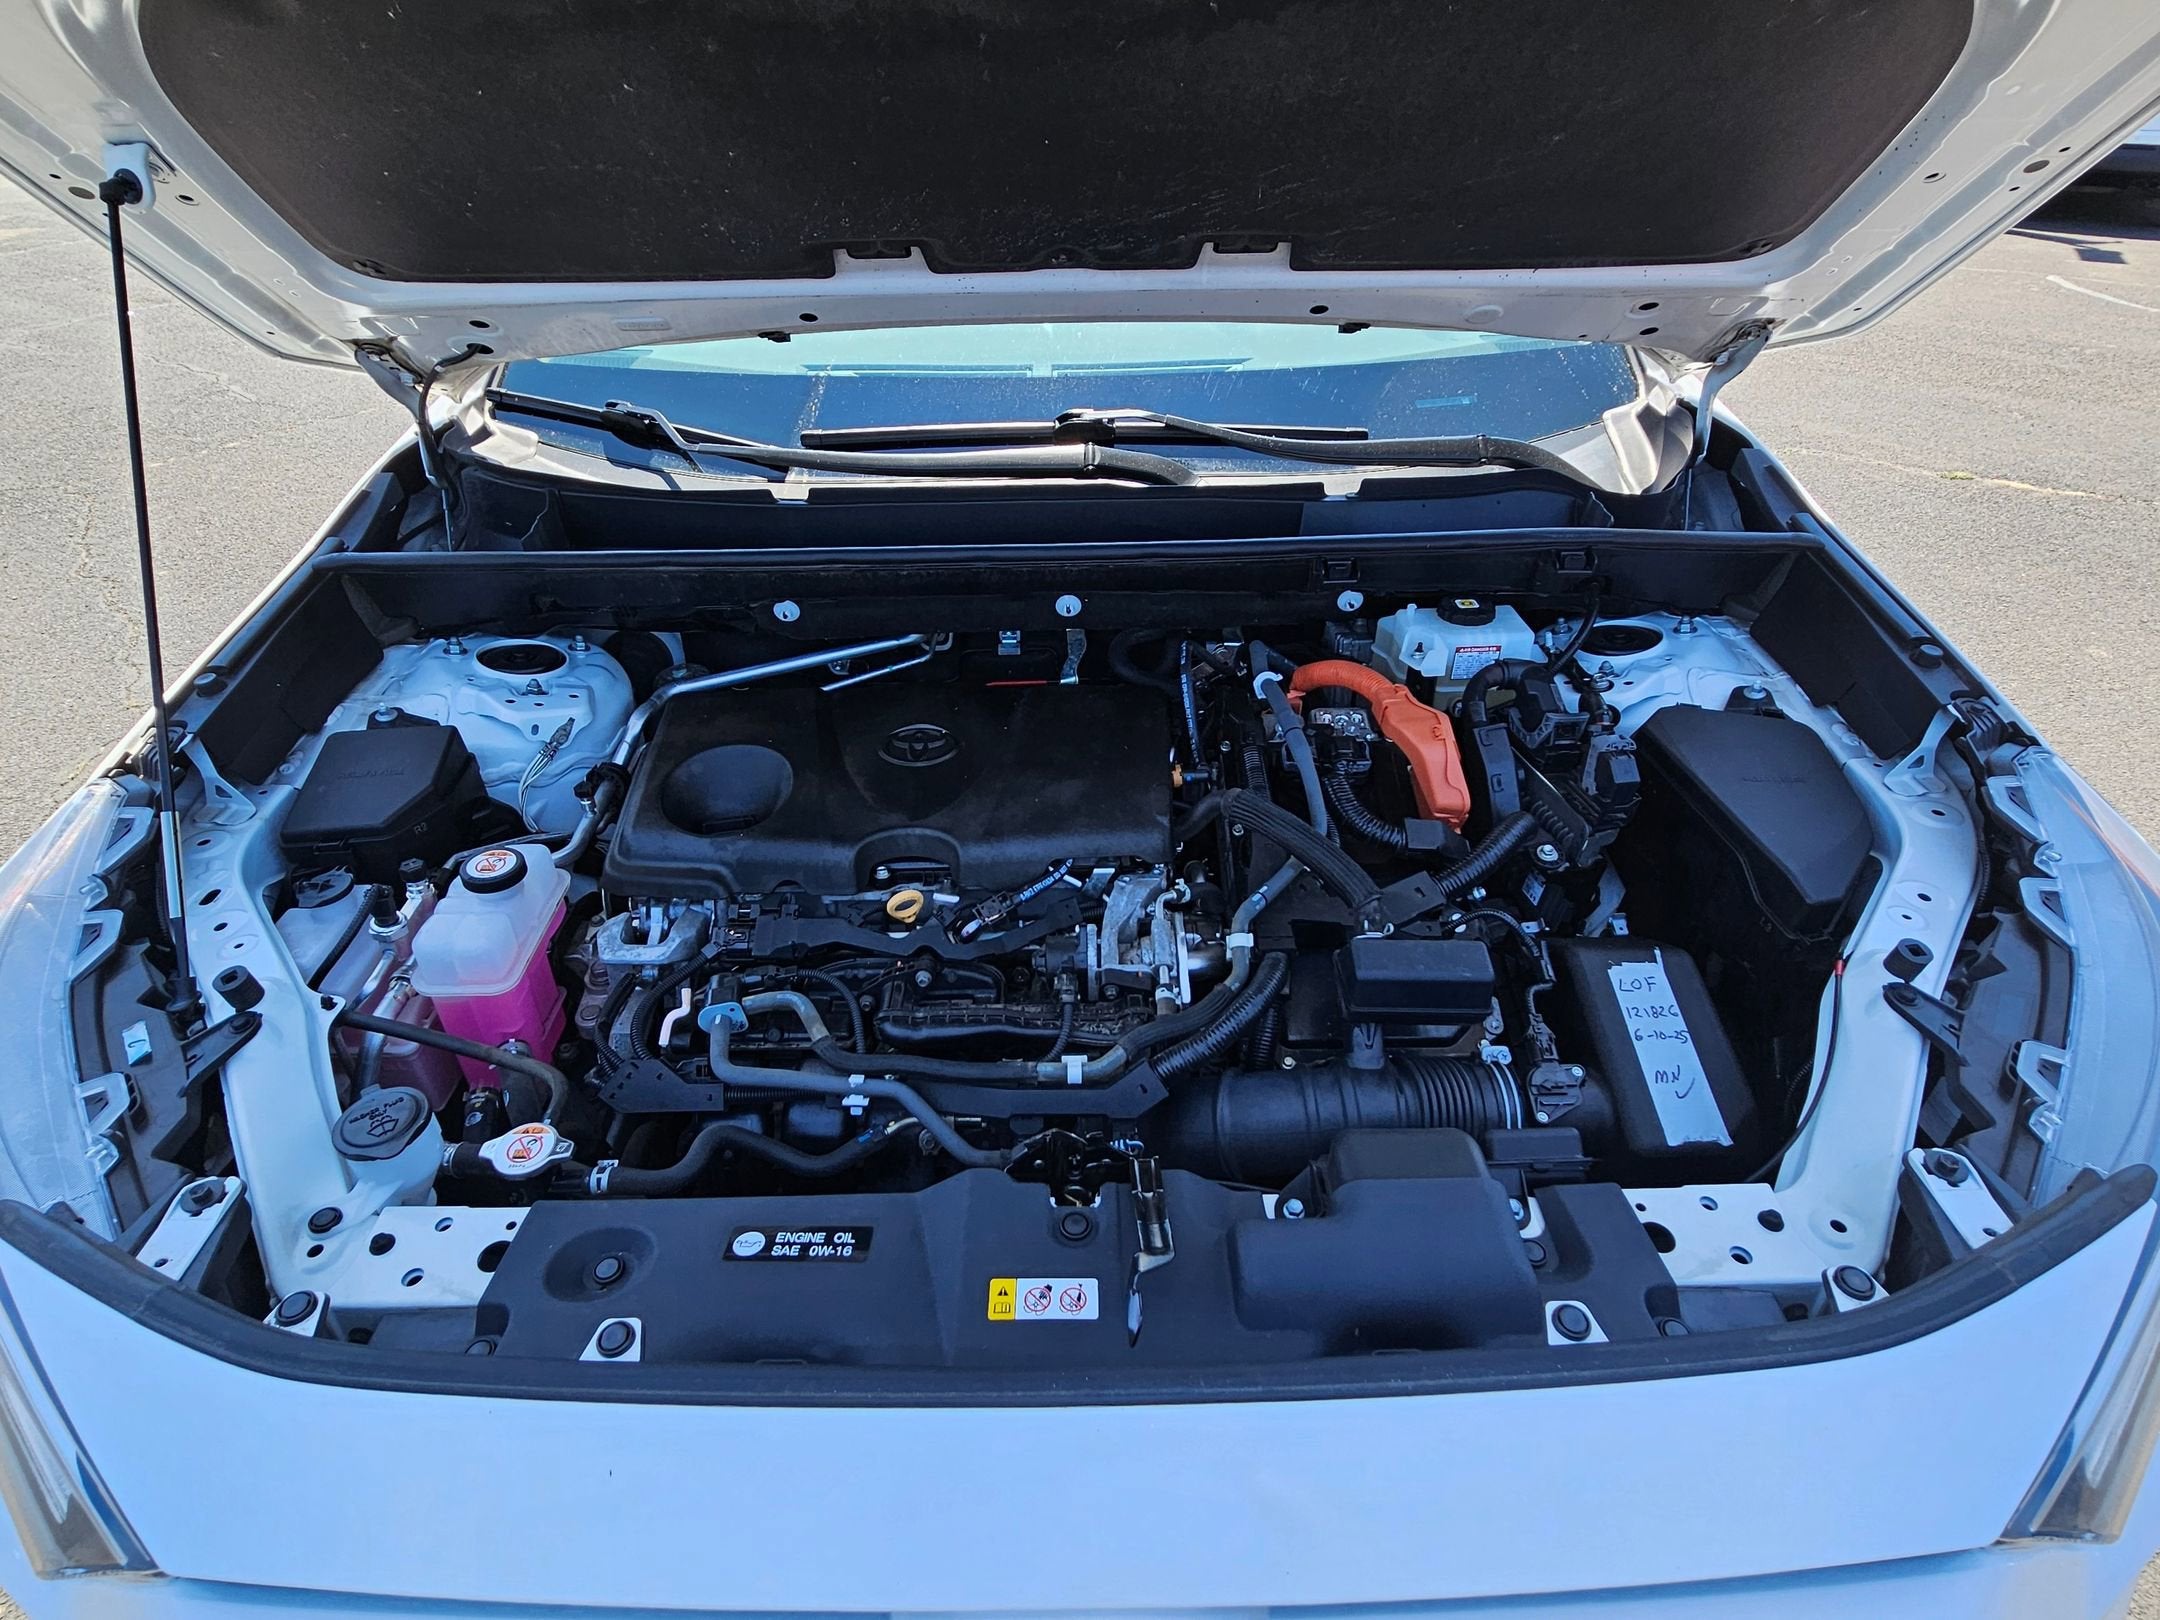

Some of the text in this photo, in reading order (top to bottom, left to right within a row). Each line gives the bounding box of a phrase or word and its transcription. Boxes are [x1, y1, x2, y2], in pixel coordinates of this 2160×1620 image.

[1619, 976, 1657, 993] LOF
[775, 1231, 856, 1244] ENGINE OIL
[771, 1244, 853, 1257] SAE 0W-16
